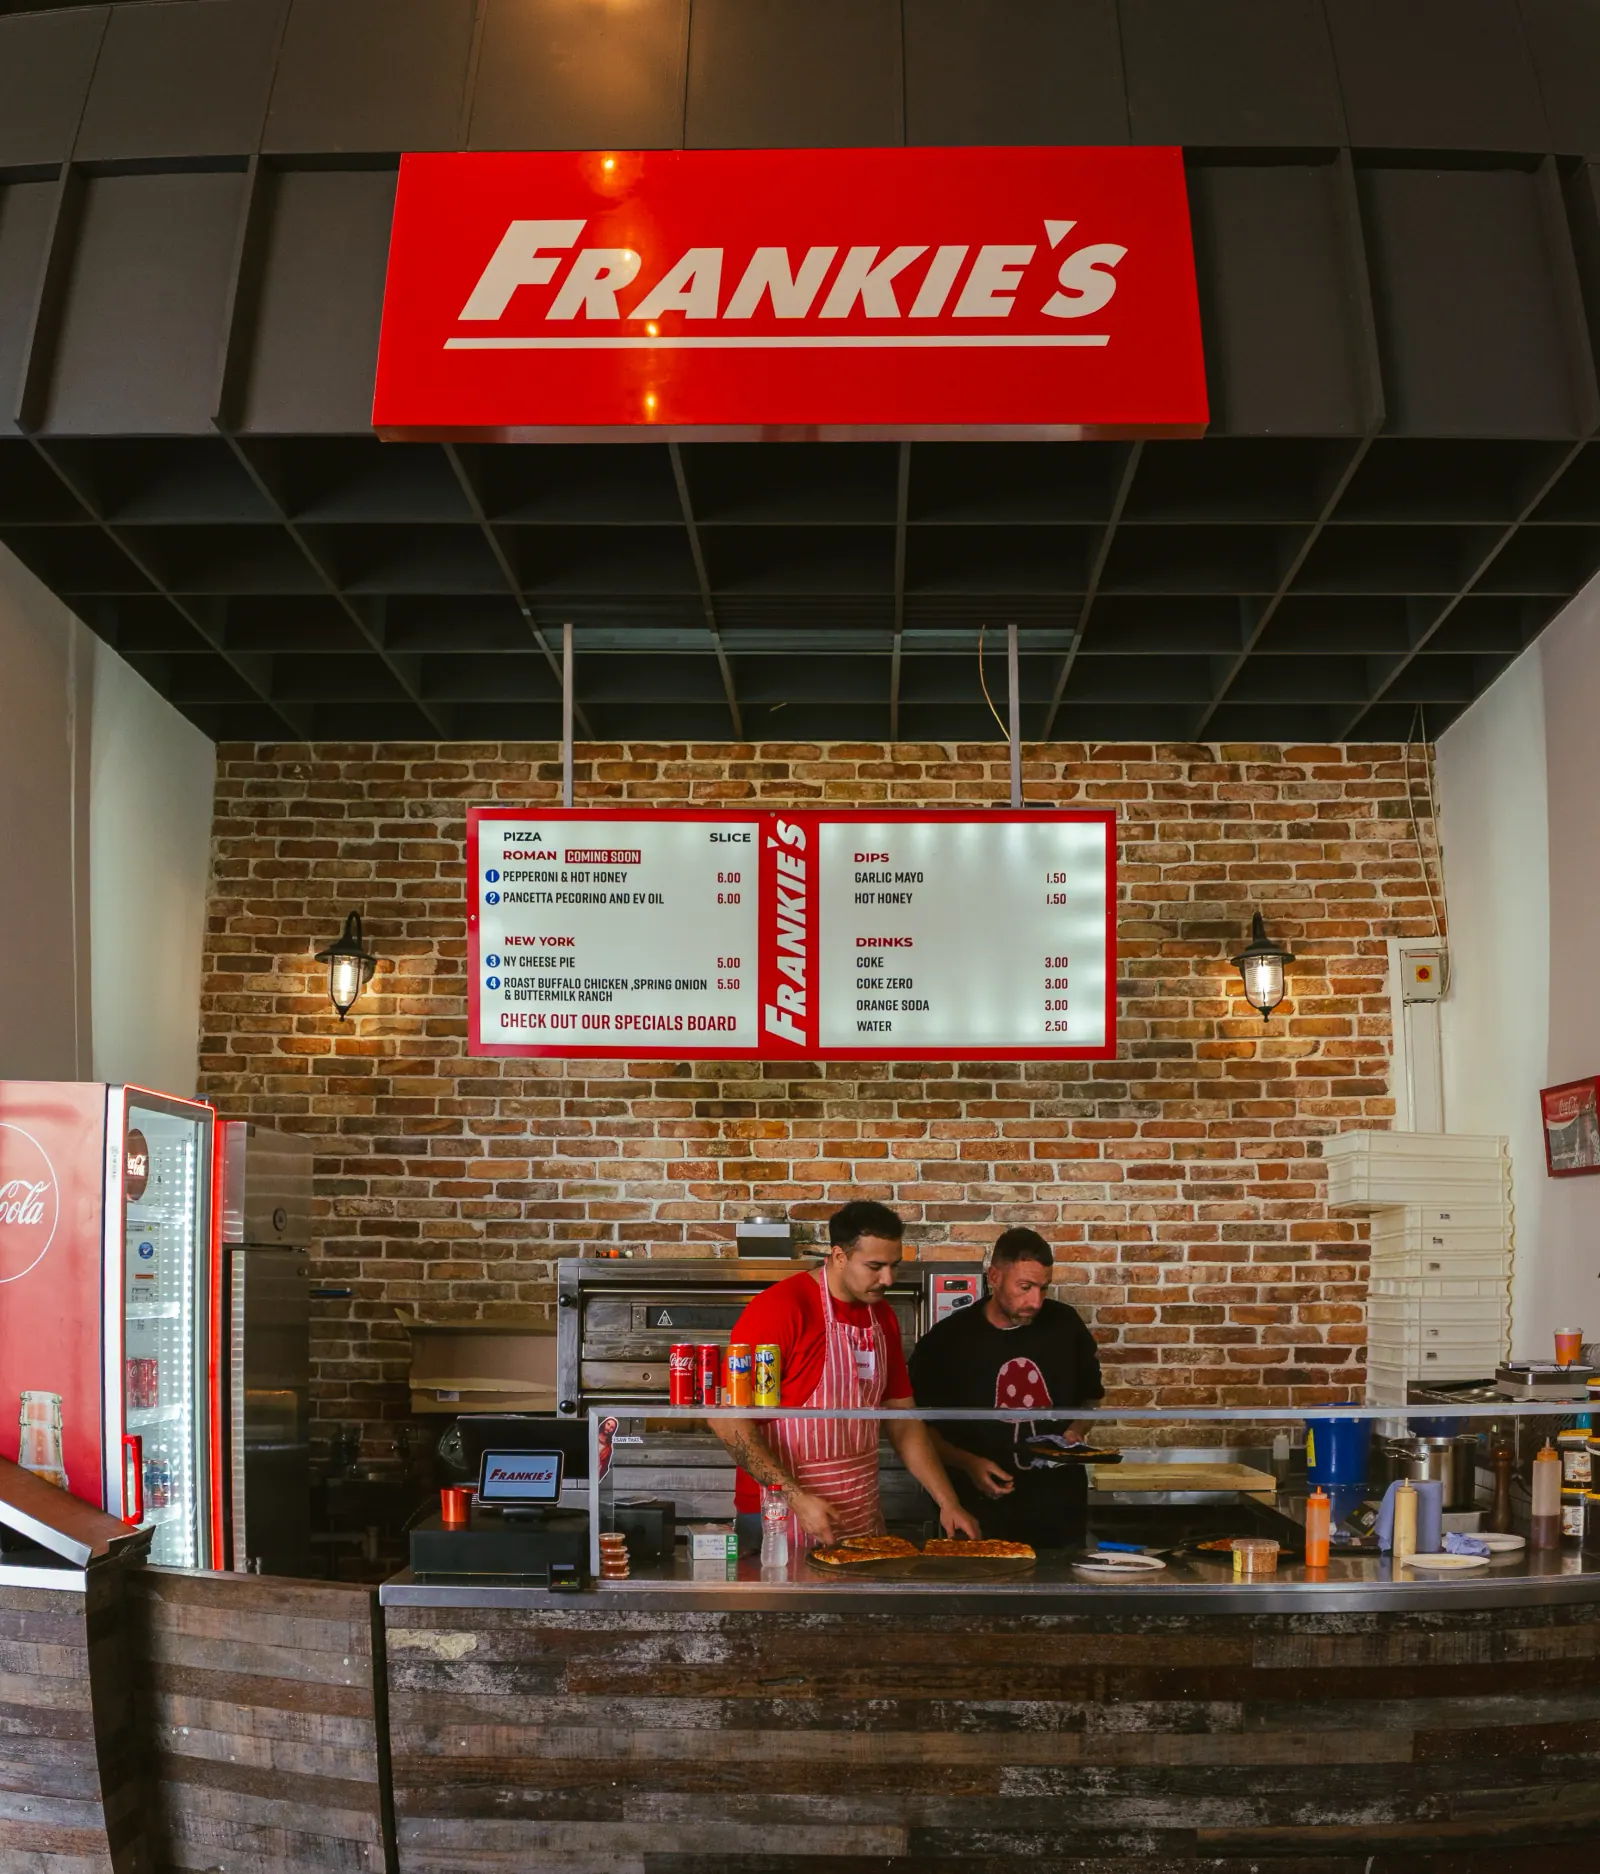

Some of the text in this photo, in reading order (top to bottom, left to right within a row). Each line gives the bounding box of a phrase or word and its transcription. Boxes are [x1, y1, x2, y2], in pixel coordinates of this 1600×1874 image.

[458, 219, 1128, 320] FRANKIE'S
[504, 832, 541, 842] PIZZA
[710, 833, 751, 842] SLICE
[503, 851, 556, 860] ROMAN
[567, 851, 639, 863] COMING SOON
[854, 853, 889, 862] DIPS
[491, 871, 627, 883] 1 PEPPERONI & HOT HONEY
[717, 872, 740, 883] 6.00
[855, 872, 923, 883] GARLIC MAYO
[1047, 873, 1066, 884] 1.50
[489, 892, 664, 904] 2 PANCETTA PECORINO AND EV OIL
[717, 894, 740, 904] 6.00
[855, 893, 912, 904] HOT HONEY
[1047, 894, 1066, 905] 1.50
[765, 820, 806, 1046] FRANKIE'S
[505, 936, 575, 947] NEW YORK
[856, 938, 913, 947] DRINKS
[489, 955, 575, 967] 3 NY CHEESE PIE
[717, 958, 740, 968] 5.00
[856, 957, 883, 968] COKE
[1045, 957, 1068, 968] 3.00
[490, 977, 497, 988] 4
[504, 978, 535, 989] ROAST
[538, 978, 581, 989] BUFFALO
[584, 978, 628, 989] CHICKEN
[675, 979, 707, 990] ONION
[717, 979, 740, 989] 5.50
[856, 979, 912, 989] COKE ZERO
[1045, 978, 1068, 989] 3.00
[504, 990, 612, 1002] & BUTTERMILK RANCH
[856, 1000, 929, 1011] ORANGE SODA
[1045, 1000, 1068, 1011] 3.00
[501, 1013, 737, 1031] CHECK OUT OUR SPECIALS BOARD
[857, 1021, 891, 1032] WATER
[1045, 1021, 1068, 1032] 2.50
[490, 1468, 553, 1480] FRANKIE'S
